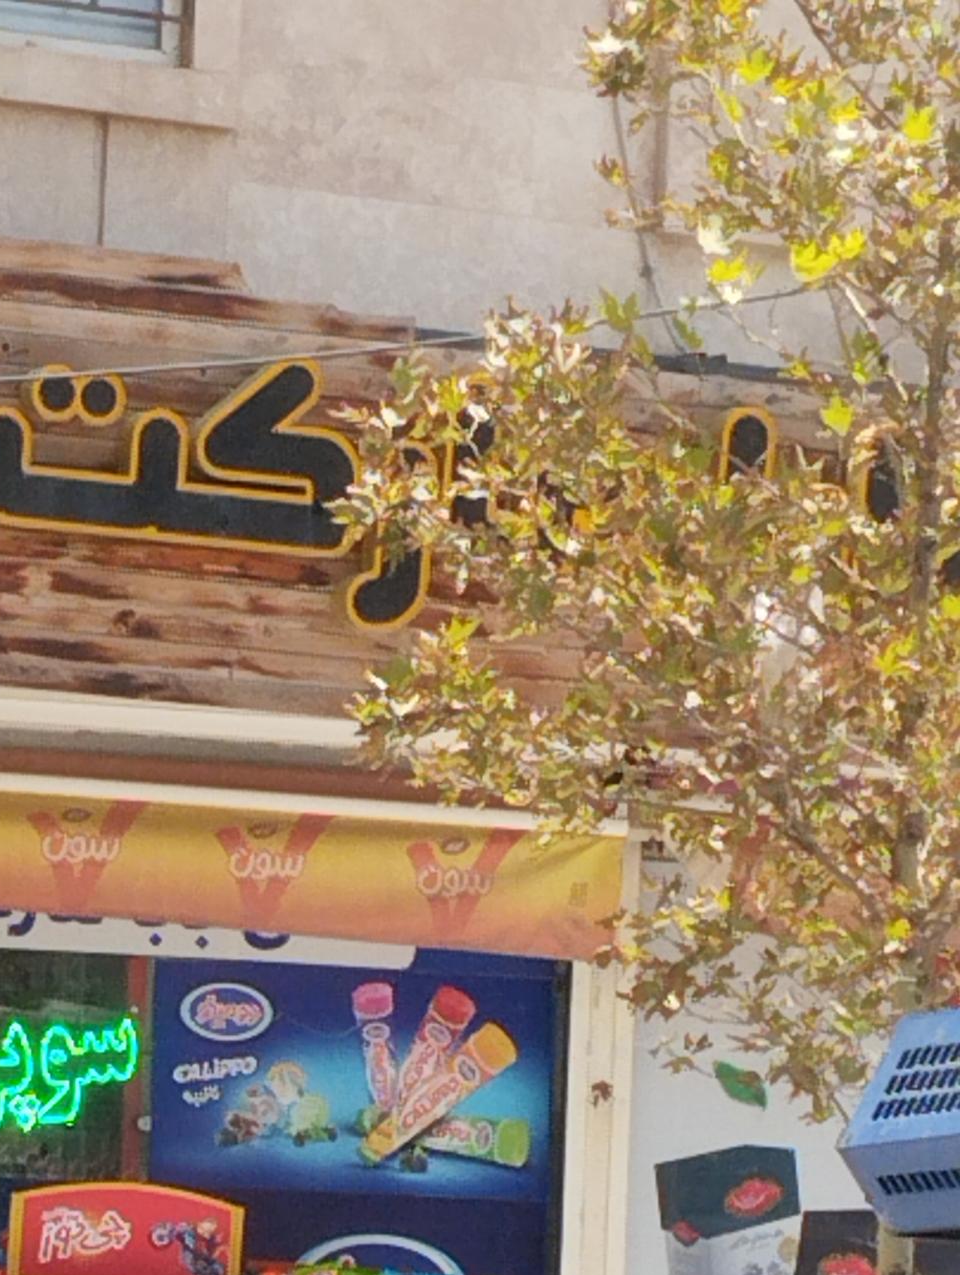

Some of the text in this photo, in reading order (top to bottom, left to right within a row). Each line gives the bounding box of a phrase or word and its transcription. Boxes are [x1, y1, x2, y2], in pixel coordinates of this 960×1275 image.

[42, 830, 120, 863] سون
[230, 846, 306, 881] سون
[417, 864, 492, 898] سون
